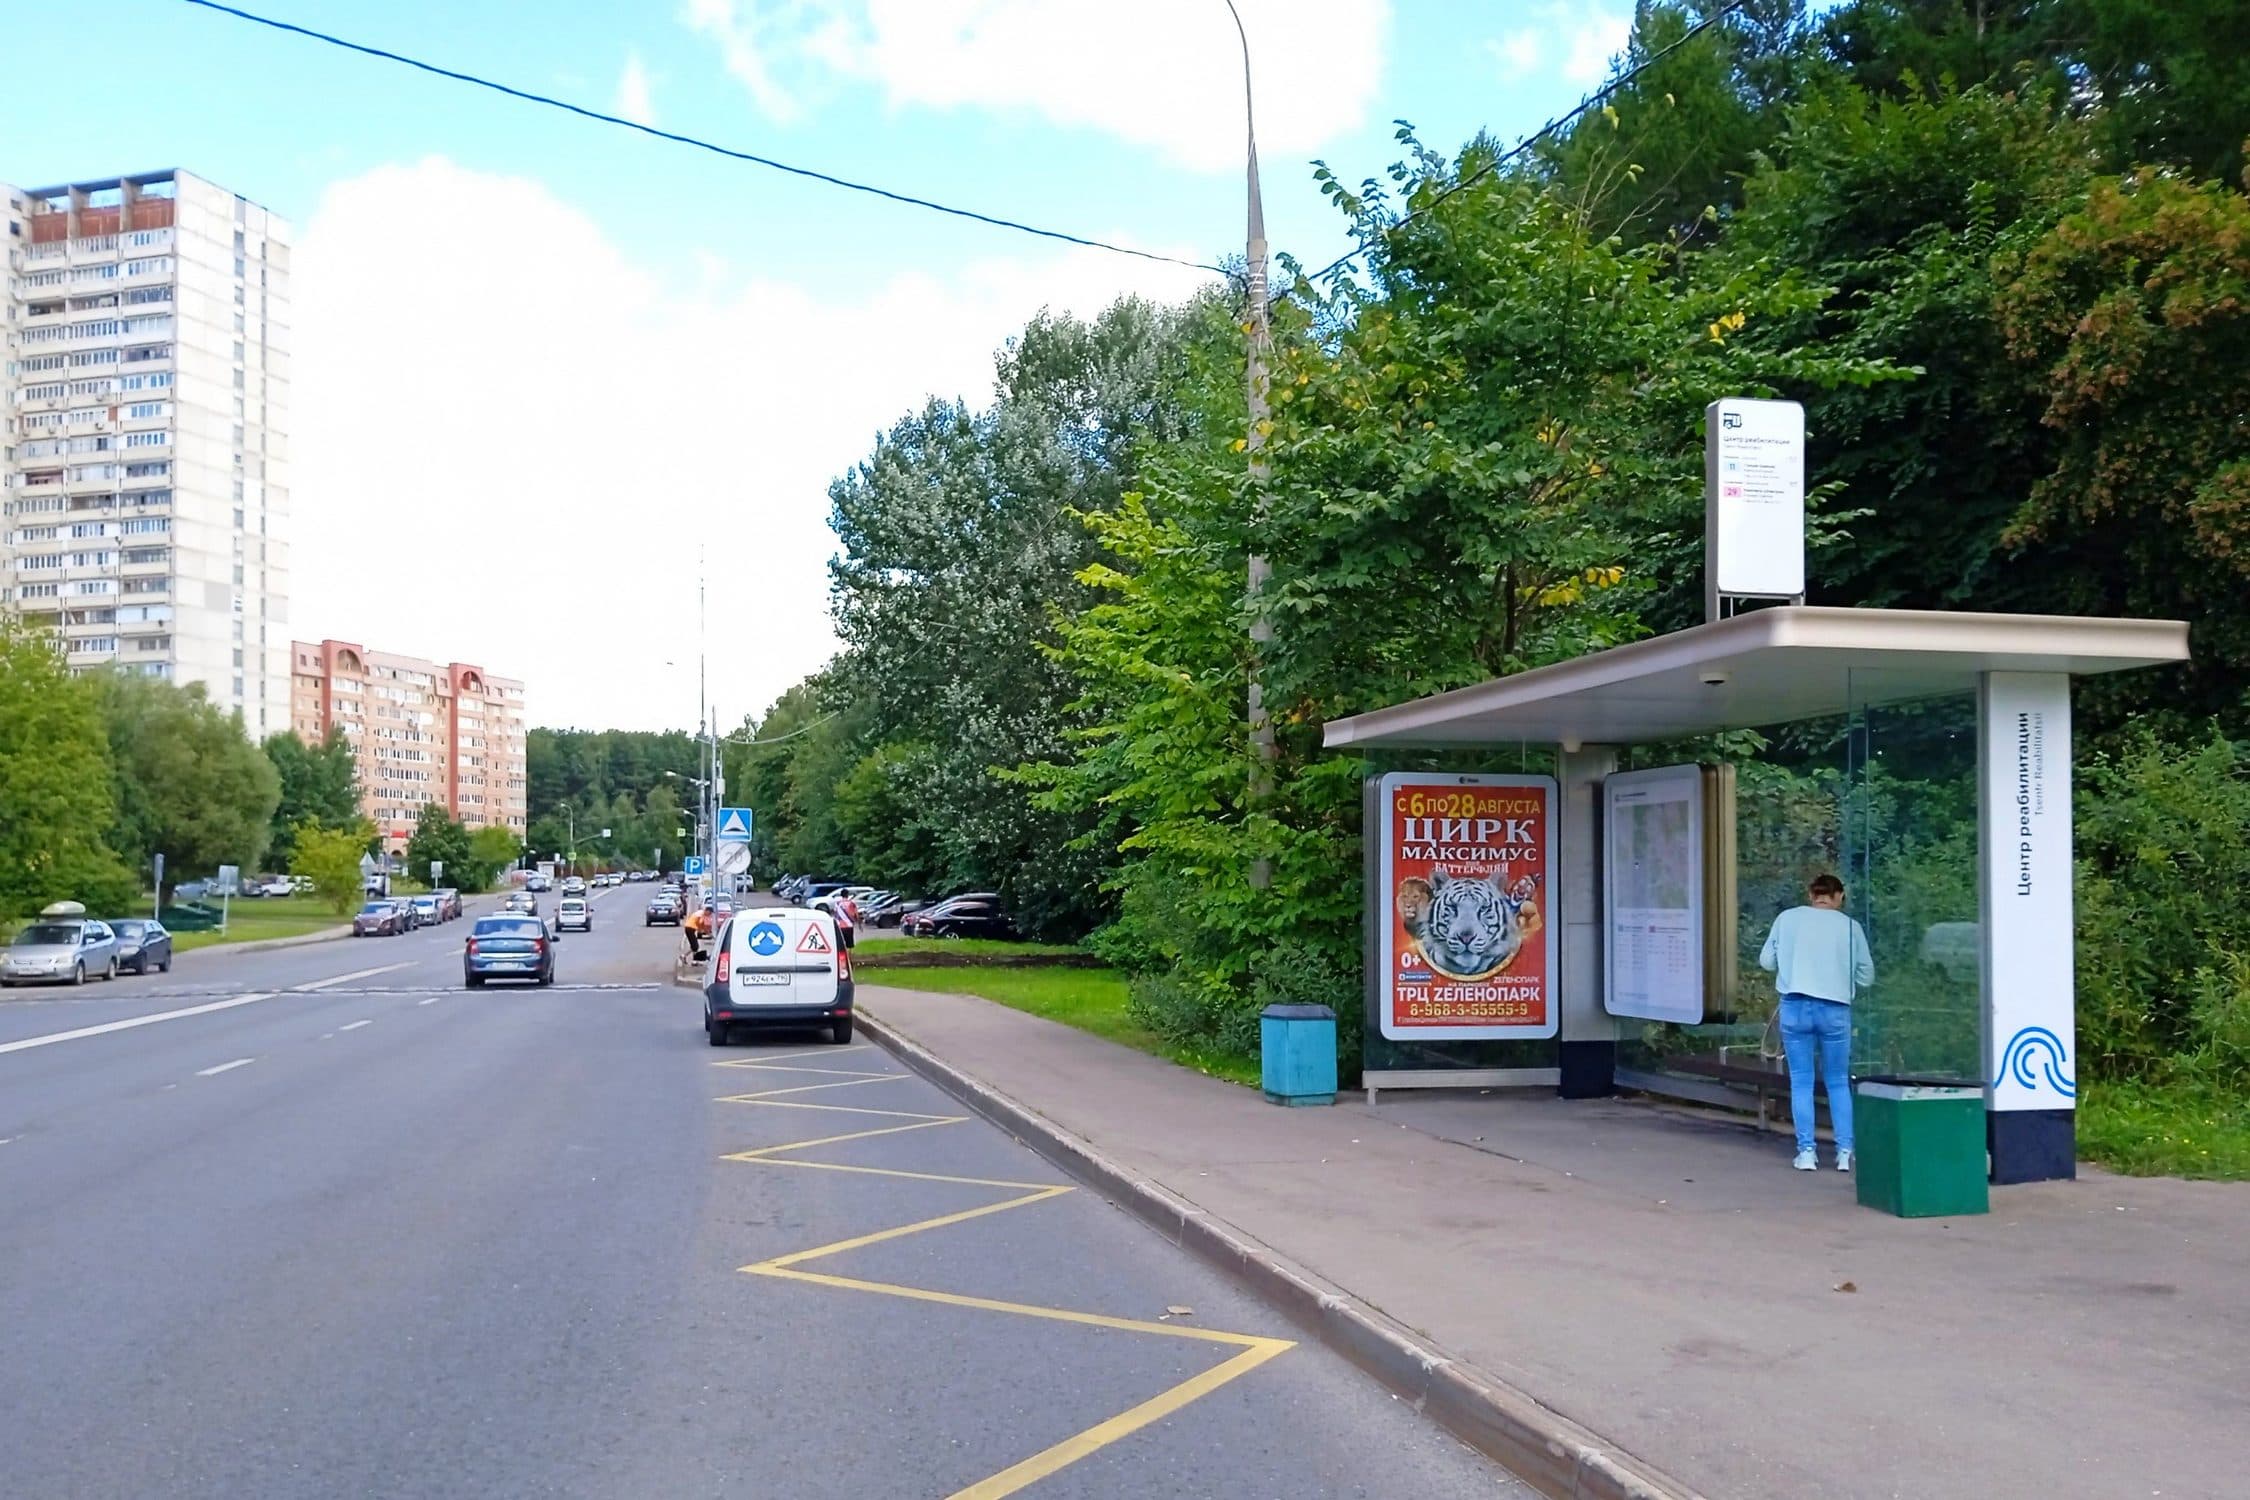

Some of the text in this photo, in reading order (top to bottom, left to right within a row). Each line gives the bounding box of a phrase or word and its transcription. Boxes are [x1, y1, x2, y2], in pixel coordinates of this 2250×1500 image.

[1396, 793, 1541, 818] С 6 ПО 28 АВГУСТА
[2016, 712, 2033, 896] Центр реабилитации
[1403, 817, 1536, 848] ЦИРК
[1401, 846, 1537, 861] МАКСИМУС
[690, 859, 700, 873] P
[1400, 952, 1422, 968] 0+
[1396, 987, 1430, 1003] ТРЦ
[1410, 1003, 1529, 1017] 8-968-3-55555-9
